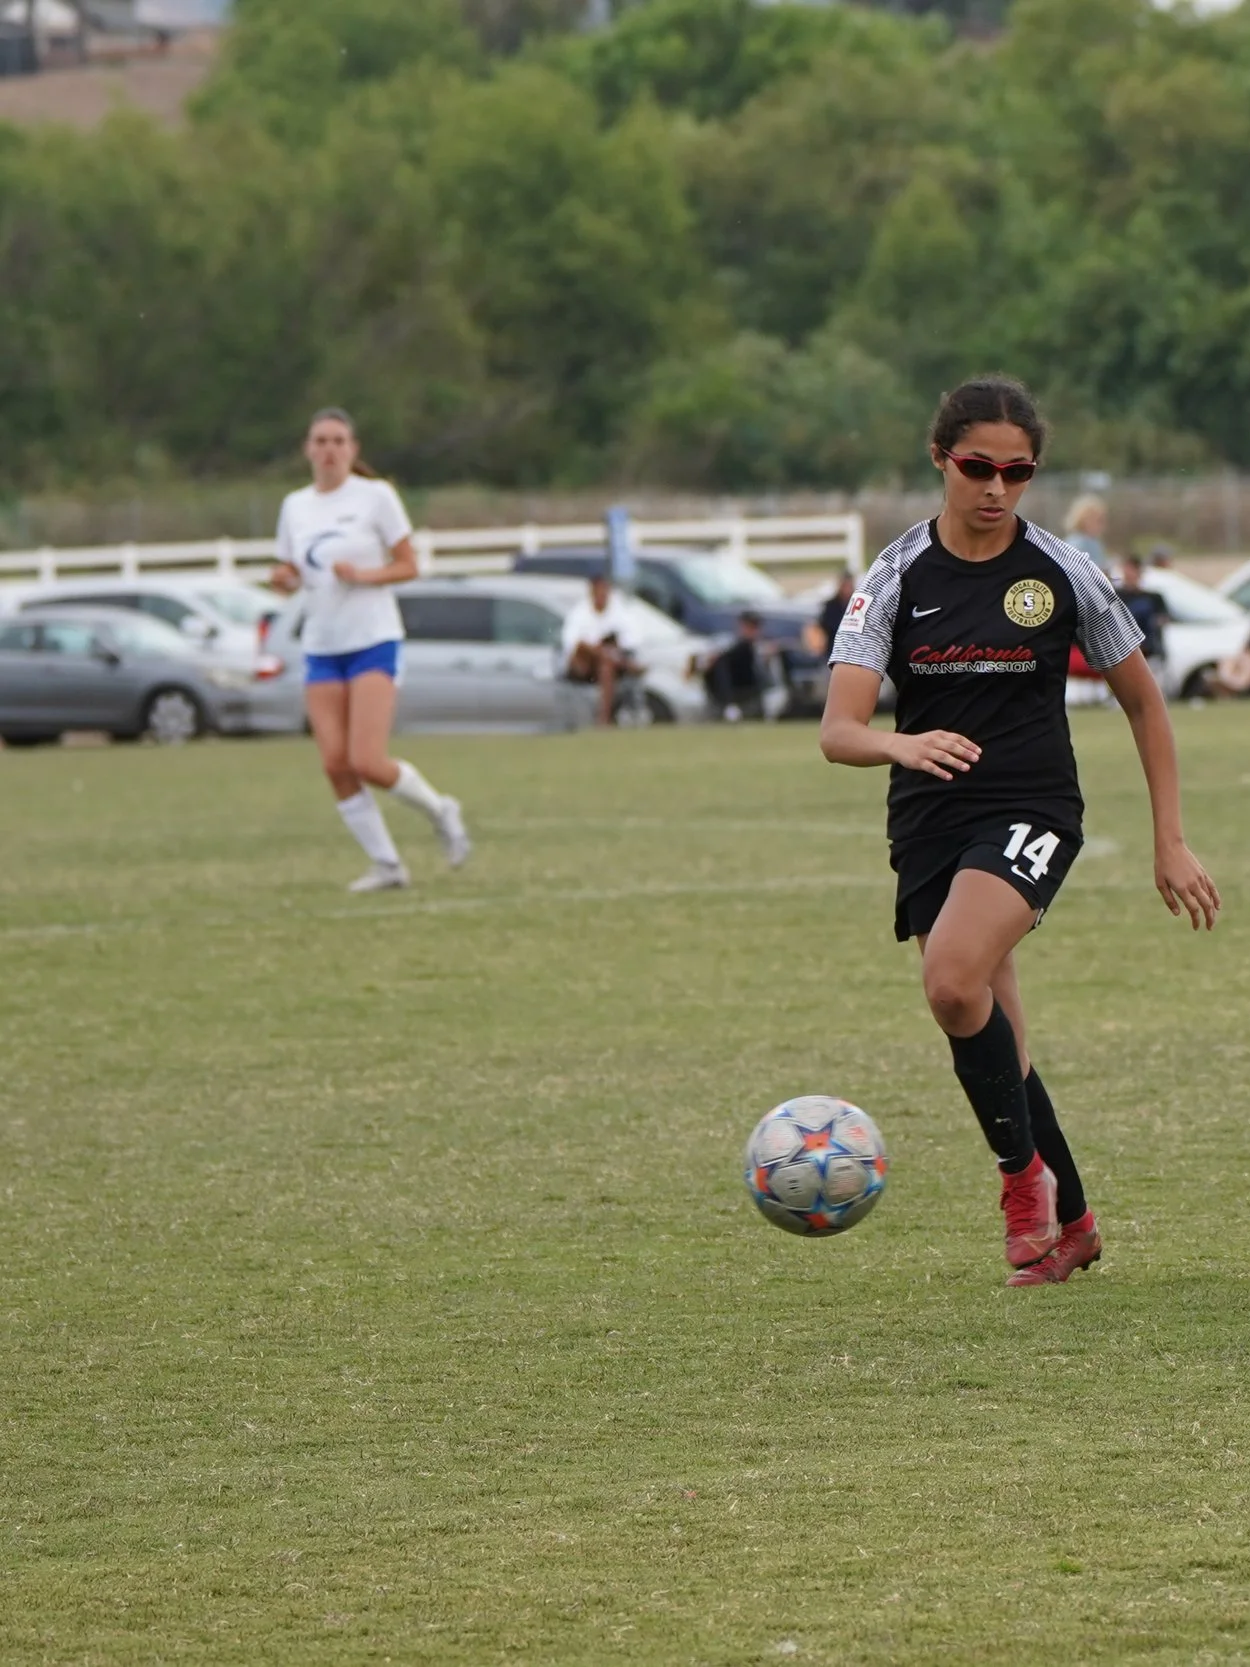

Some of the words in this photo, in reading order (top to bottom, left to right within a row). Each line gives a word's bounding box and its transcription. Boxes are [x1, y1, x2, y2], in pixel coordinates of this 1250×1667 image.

[1010, 581, 1031, 595] SOCAL
[1032, 581, 1050, 595] ELITE
[1006, 606, 1036, 626] FOOTBALL
[1036, 607, 1052, 624] CLUB
[910, 644, 1034, 664] California
[909, 660, 1037, 675] TRANSMISSION
[1003, 822, 1061, 881] 14
